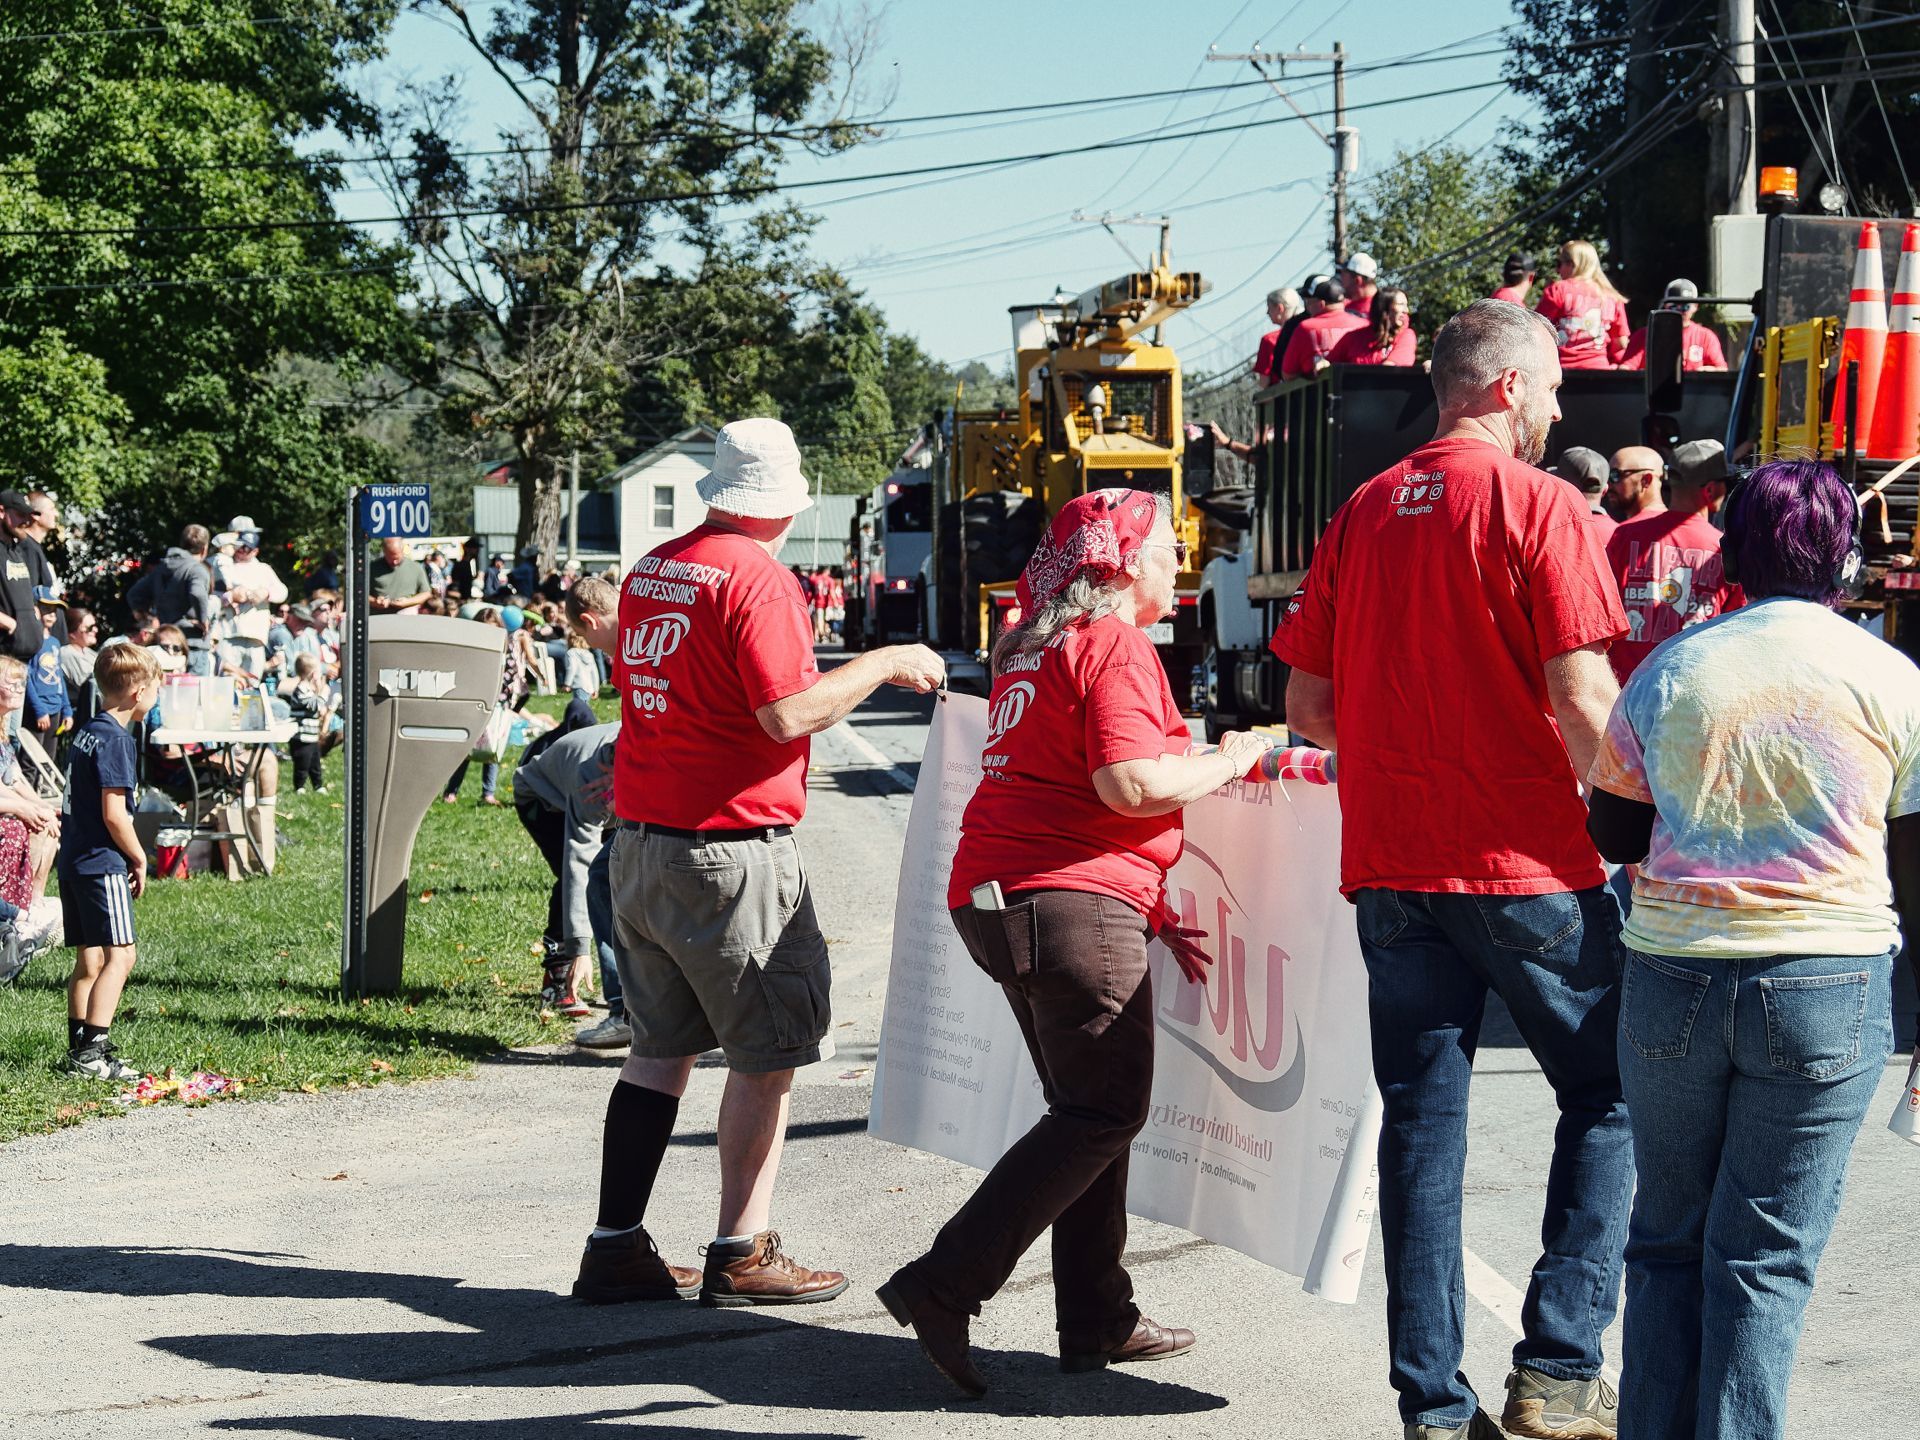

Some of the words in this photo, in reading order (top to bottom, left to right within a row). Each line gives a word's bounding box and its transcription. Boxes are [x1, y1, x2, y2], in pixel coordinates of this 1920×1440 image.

[1403, 472, 1430, 483] Follow
[1431, 470, 1446, 481] Us!
[371, 485, 427, 497] RUSHFORD
[370, 499, 430, 534] 9100
[1396, 503, 1433, 516] @uupinfo
[658, 558, 731, 590] UNIVERSITY
[626, 576, 700, 606] PROFESSIONS
[623, 619, 682, 667] uup
[629, 672, 652, 688] FOLLOW
